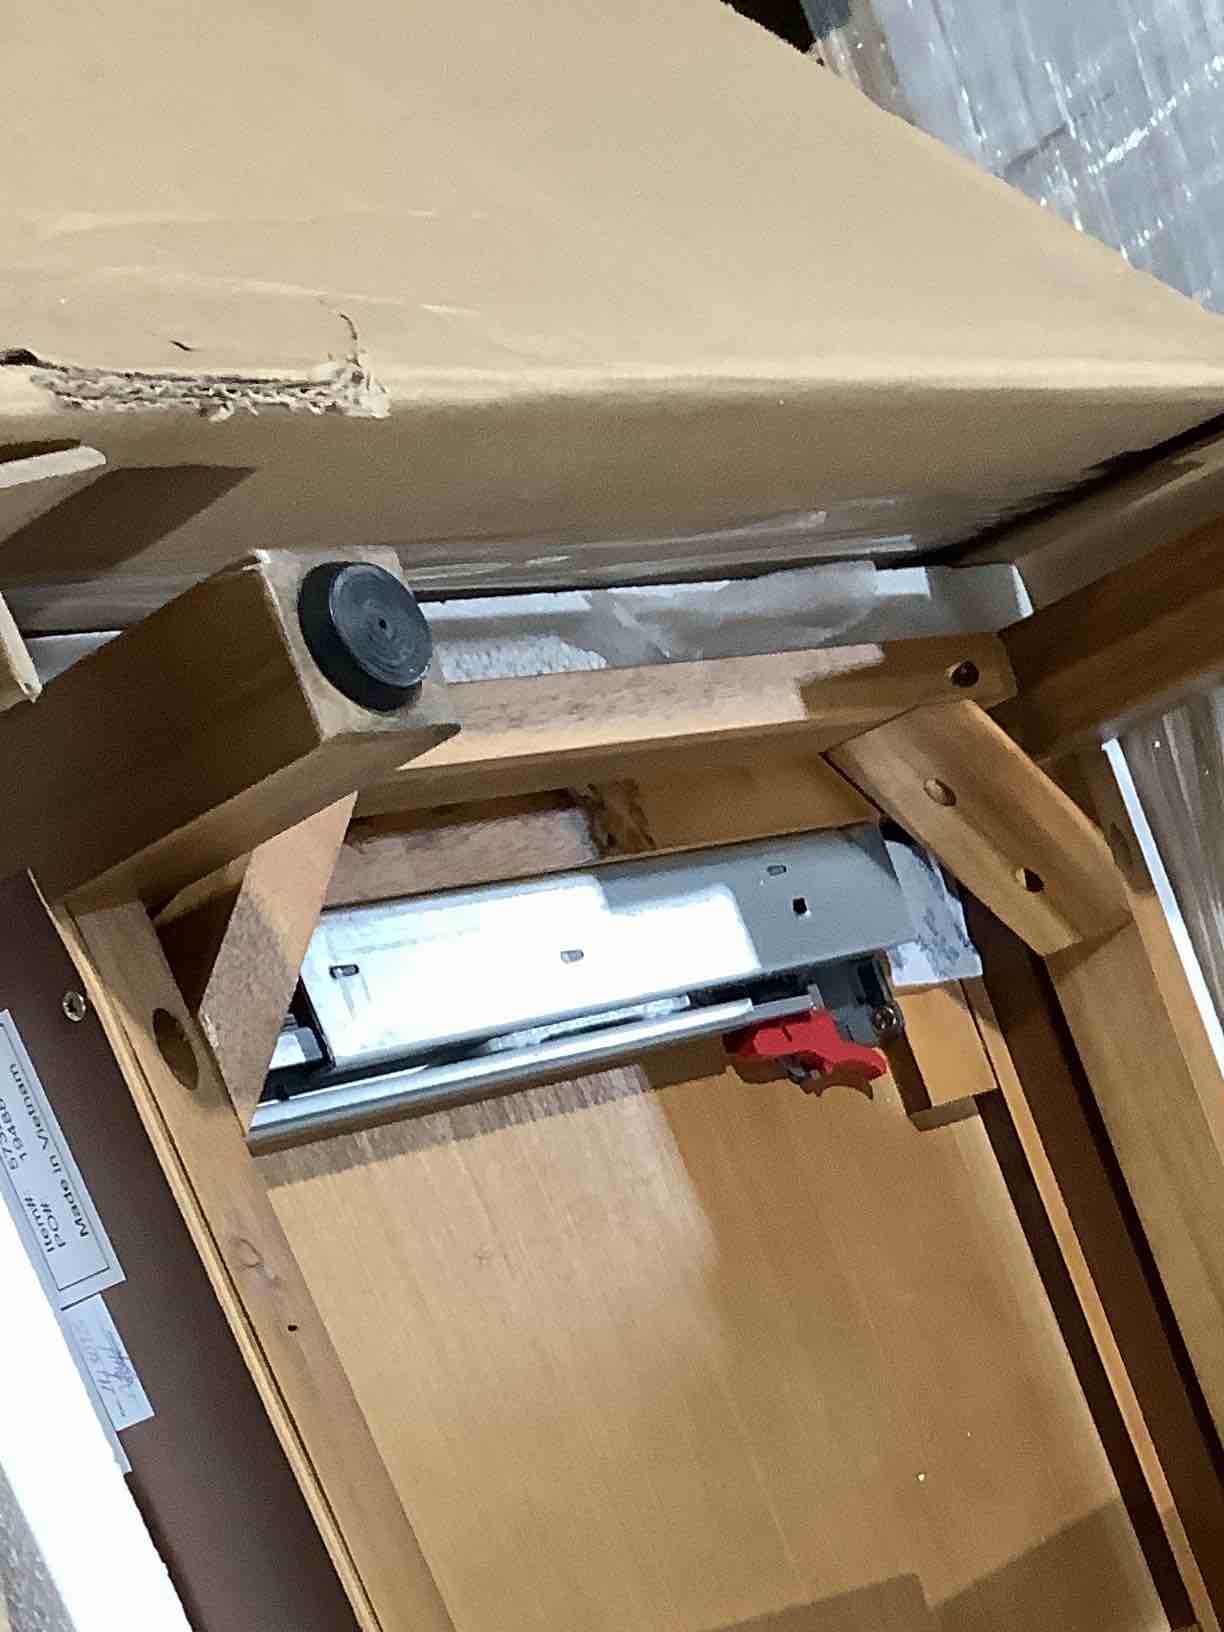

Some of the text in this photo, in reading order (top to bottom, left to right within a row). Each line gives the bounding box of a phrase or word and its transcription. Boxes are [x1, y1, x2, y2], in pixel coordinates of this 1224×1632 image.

[9, 1062, 89, 1238] Made in Vietnam
[40, 1203, 67, 1249] PO#
